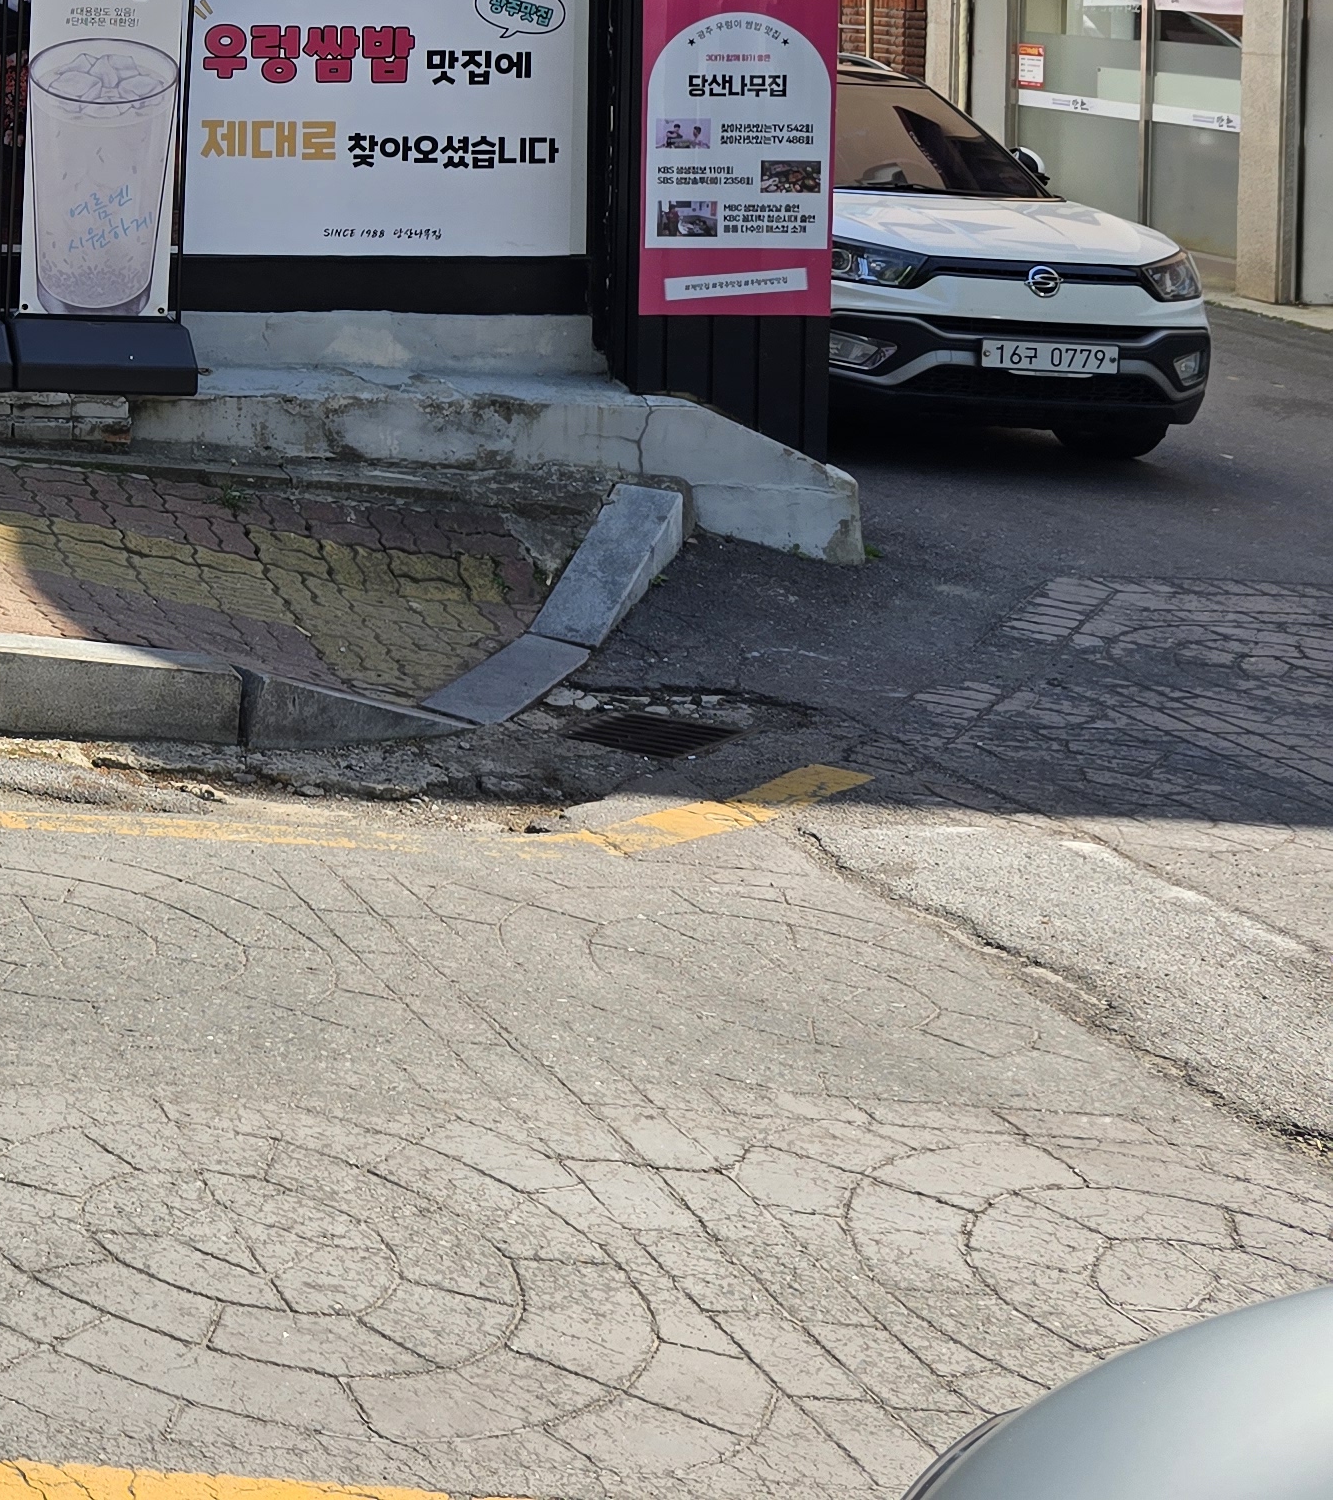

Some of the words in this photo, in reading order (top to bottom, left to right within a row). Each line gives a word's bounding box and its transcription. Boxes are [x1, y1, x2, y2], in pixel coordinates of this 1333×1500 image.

[70, 7, 111, 16] #대용량도
[114, 7, 135, 17] 있음!
[65, 17, 107, 27] #단체주문
[696, 26, 713, 40] 광주
[764, 25, 781, 40] 맛집
[202, 23, 415, 84] 우렁쌈밥
[426, 49, 532, 85] 맛집에
[688, 74, 788, 98] 당산나무집
[786, 123, 814, 134] 542회
[200, 119, 337, 161] 제대로
[347, 132, 560, 169] 찾아오셨습니다
[658, 166, 674, 174] KBS
[657, 176, 674, 186] SBS
[69, 185, 132, 220] 여름엔
[723, 204, 742, 213] MBC
[723, 214, 741, 223] KBC
[68, 212, 153, 252] 시원하게
[323, 228, 356, 238] SINCE
[360, 228, 385, 238] 1988
[791, 224, 807, 234] 소개
[995, 343, 1038, 366] 16구
[1049, 347, 1106, 369] 0779
